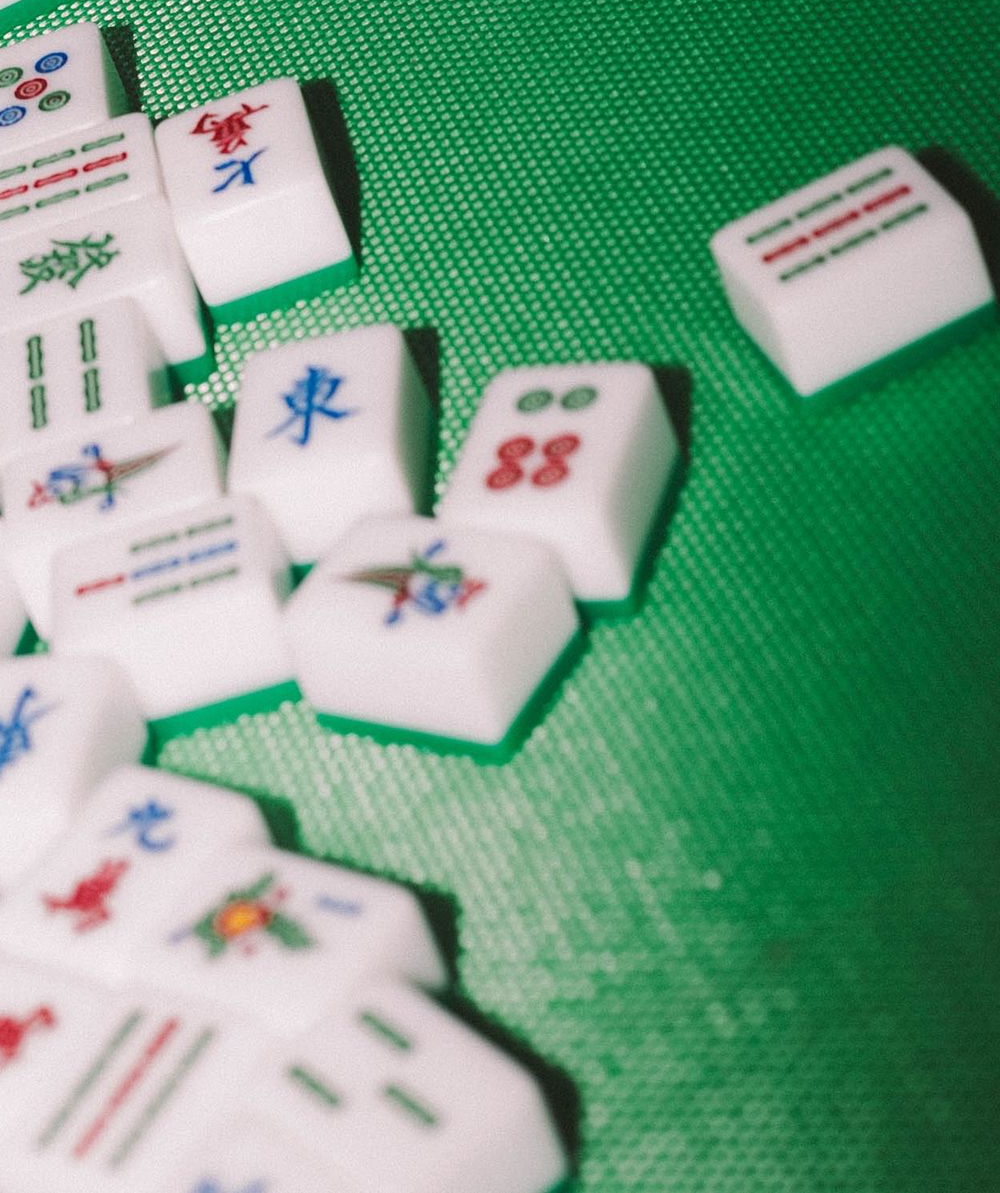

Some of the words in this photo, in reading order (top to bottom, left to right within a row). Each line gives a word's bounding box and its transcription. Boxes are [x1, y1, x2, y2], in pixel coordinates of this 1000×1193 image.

[190, 102, 269, 194] 七萬
[20, 233, 117, 293] 發
[266, 364, 356, 448] 東
